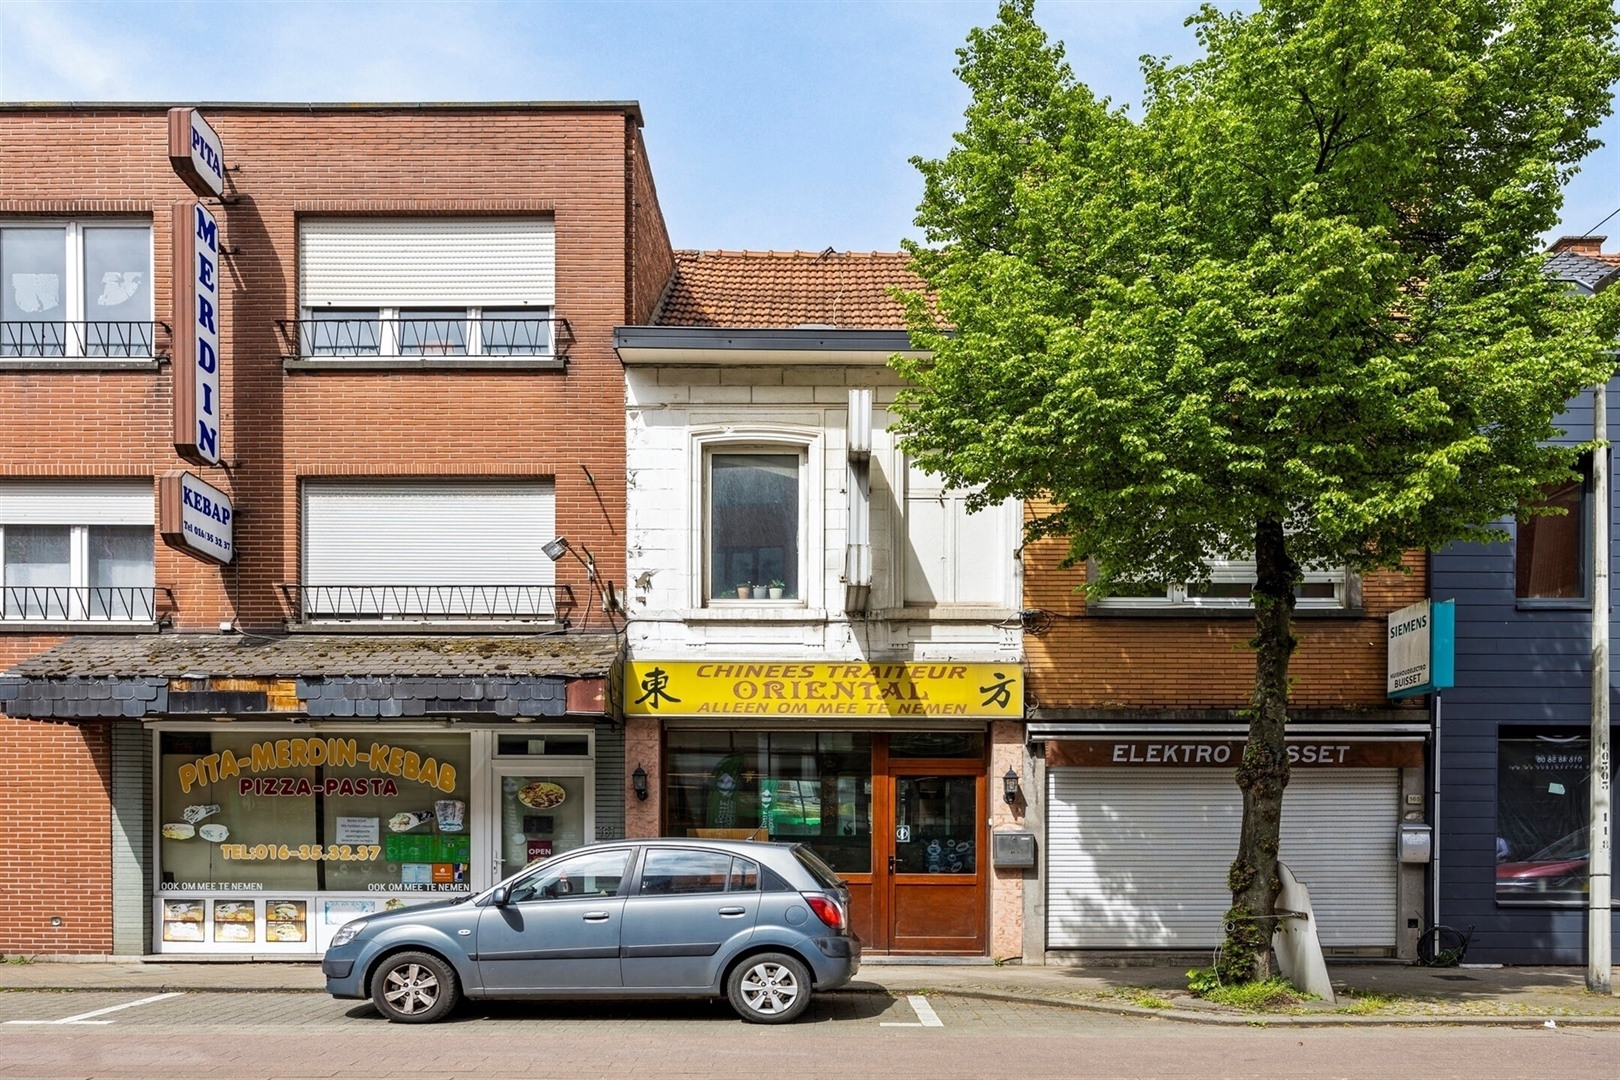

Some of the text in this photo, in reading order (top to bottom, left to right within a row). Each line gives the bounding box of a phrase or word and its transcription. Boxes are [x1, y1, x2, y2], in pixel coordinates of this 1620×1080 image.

[191, 126, 222, 180] PITA
[196, 206, 217, 458] MERDIN
[183, 486, 230, 526] KEBAP
[183, 520, 231, 551] Tel 016/35 32 37
[1390, 615, 1427, 639] SIEMENS
[696, 664, 967, 680] CHINEES TRAITEUR
[1394, 673, 1421, 689] BUISSET
[635, 667, 682, 710] 東
[733, 680, 929, 701] ORIENTAL
[979, 673, 1016, 709] 方
[696, 701, 967, 715] ALLEEN OM MEE TE NEMEN
[1112, 744, 1351, 763] ELEKTRO SSET
[178, 738, 457, 794] PITA-MERDIN-KEBAB
[239, 777, 399, 797] PIZZA-PASTA
[599, 826, 615, 838] 161
[220, 844, 382, 861] TEL:016-35.32.37
[528, 848, 552, 856] OPEN
[161, 882, 263, 891] OOK OM MEE TE NEMEN
[368, 883, 470, 892] OOK OM MEE TE NEMEN
